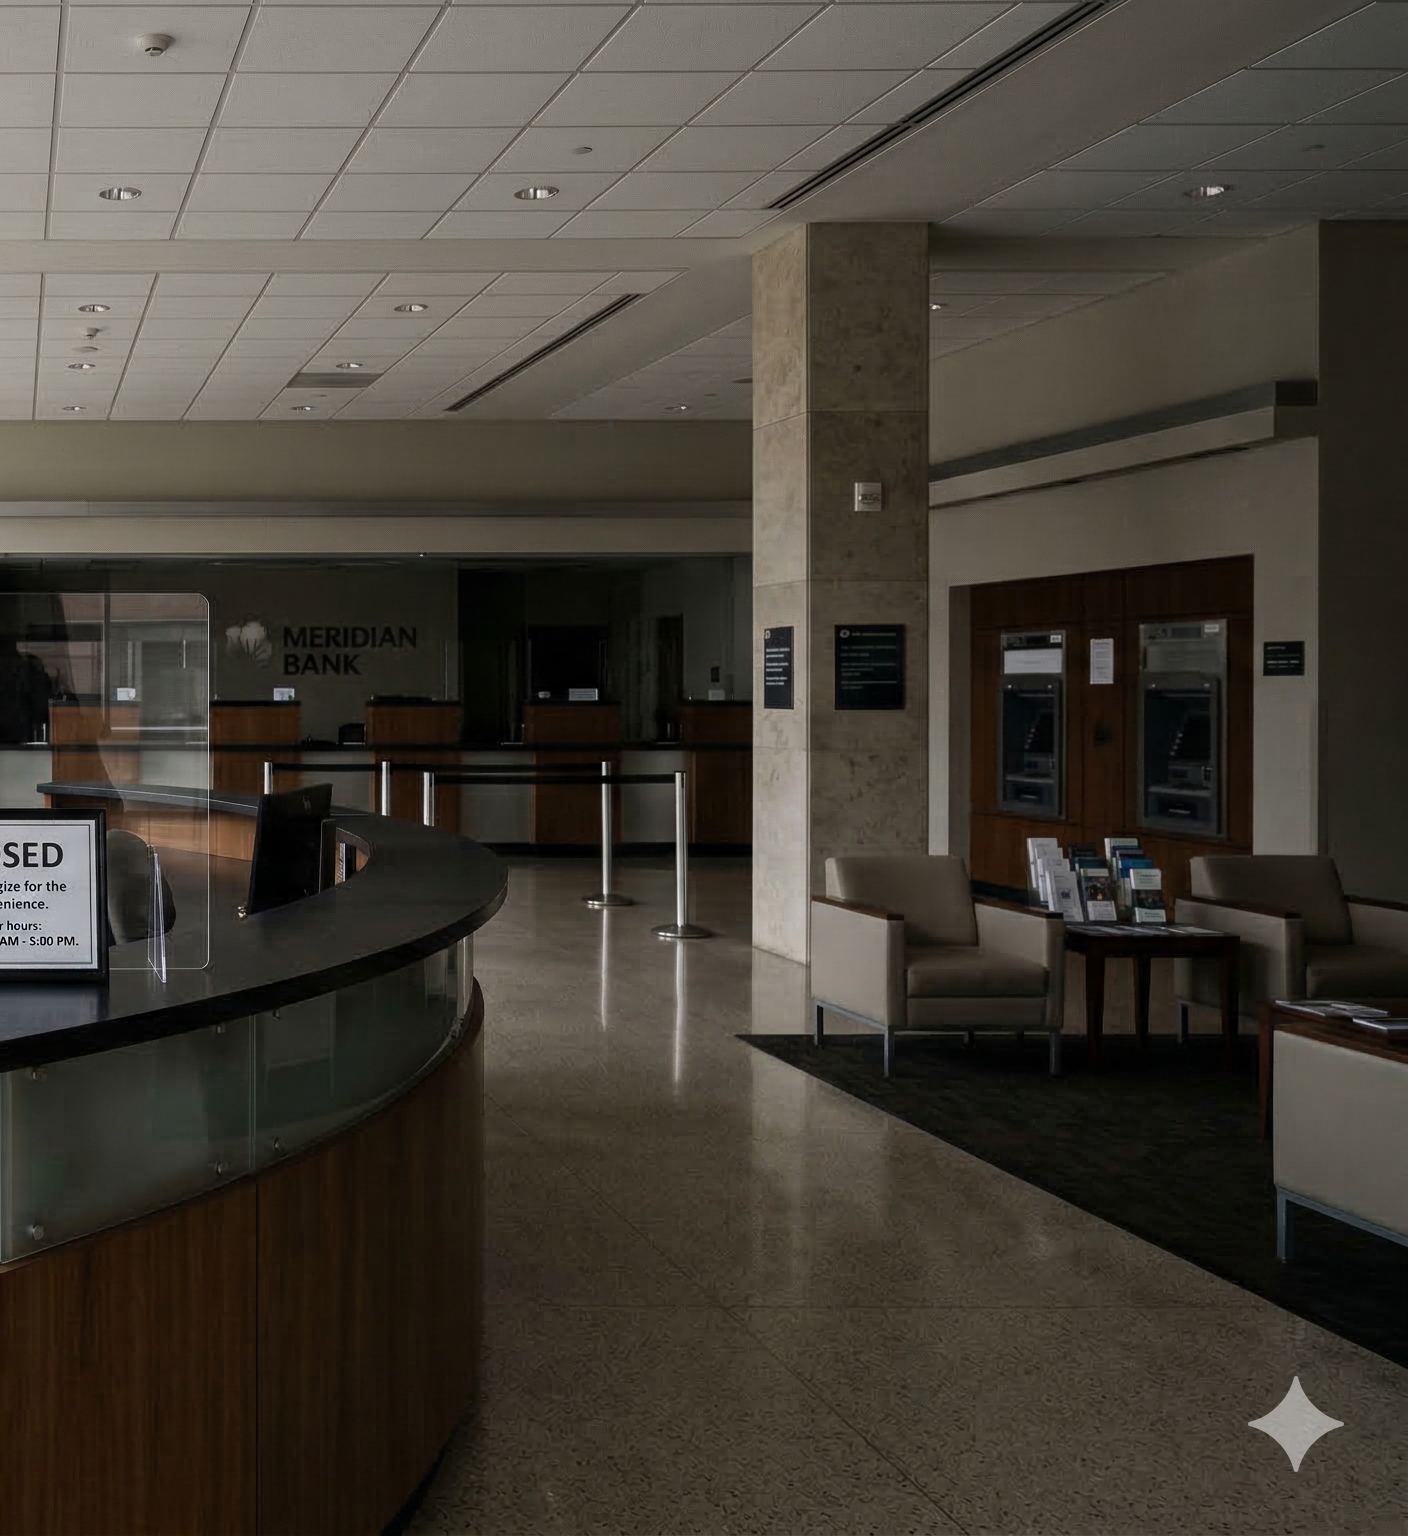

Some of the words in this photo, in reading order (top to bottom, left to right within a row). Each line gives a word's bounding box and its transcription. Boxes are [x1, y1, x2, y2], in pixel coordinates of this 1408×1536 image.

[283, 626, 417, 648] MERIDIAN
[283, 653, 361, 675] BANK
[24, 880, 42, 892] for
[46, 880, 67, 892] the
[6, 920, 42, 931] hours:
[0, 936, 19, 946] AM
[56, 936, 79, 946] PM.
